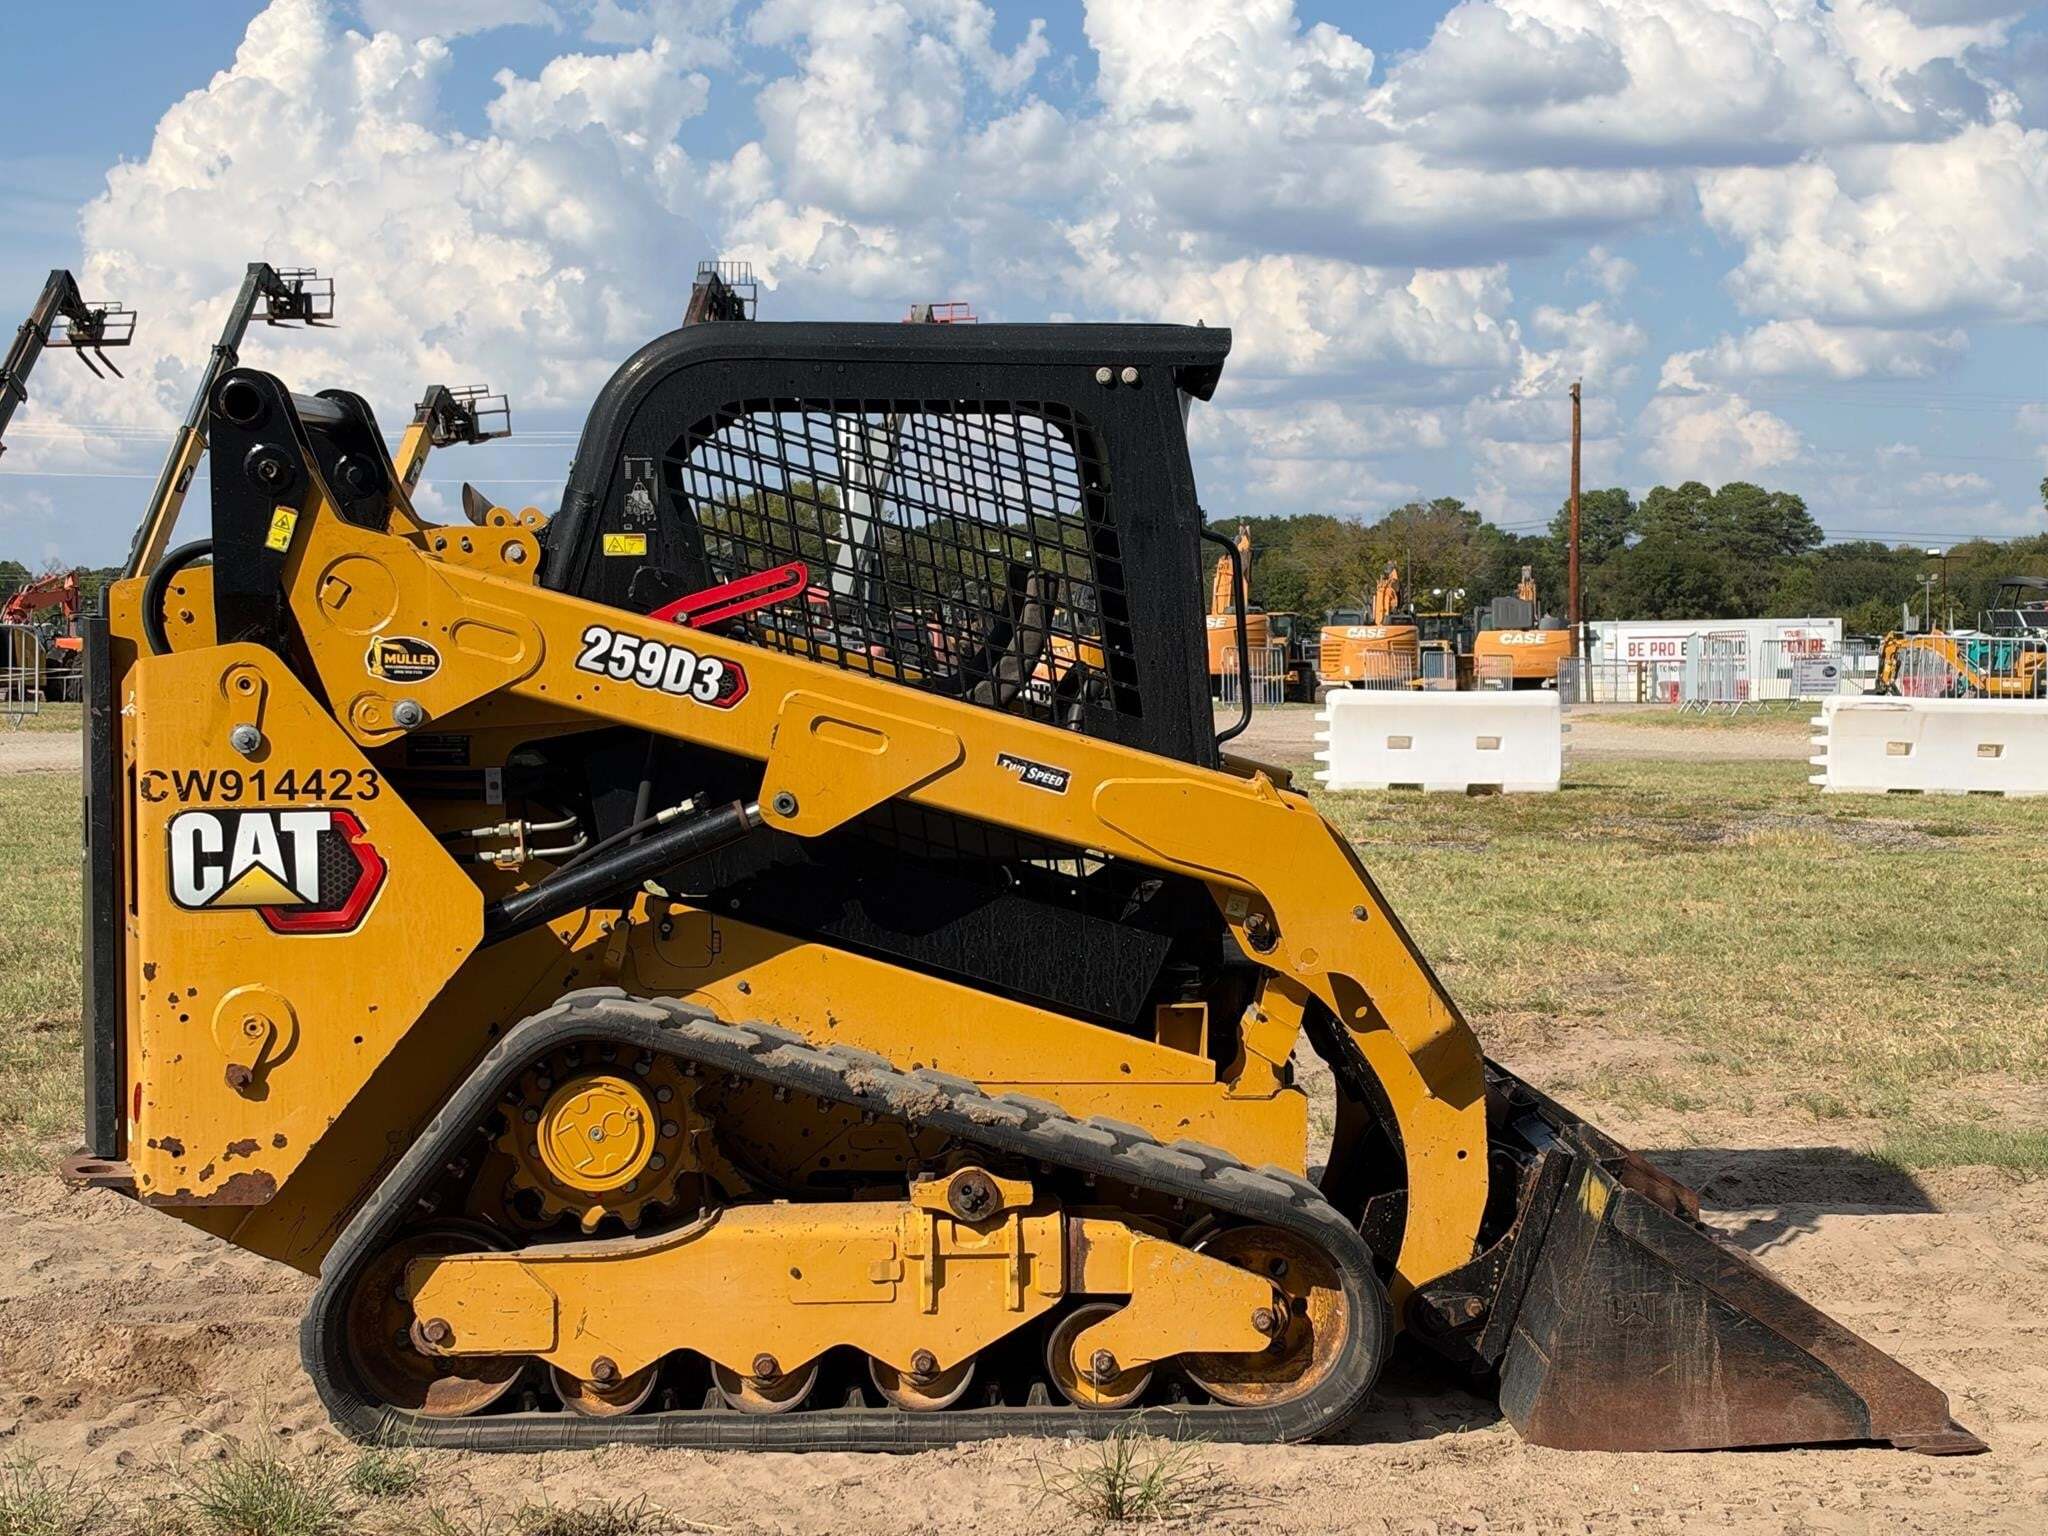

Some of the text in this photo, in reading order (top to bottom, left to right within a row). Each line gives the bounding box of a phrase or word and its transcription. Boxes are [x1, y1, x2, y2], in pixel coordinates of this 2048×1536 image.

[1206, 617, 1226, 628] SE
[1347, 627, 1387, 639] CASE
[1500, 632, 1546, 645] CASE
[1628, 642, 1645, 657] BE
[1650, 642, 1675, 656] PRO
[384, 653, 436, 665] MULLER
[577, 627, 724, 701] 259D3
[141, 769, 380, 802] CW914423
[170, 811, 331, 907] CAT
